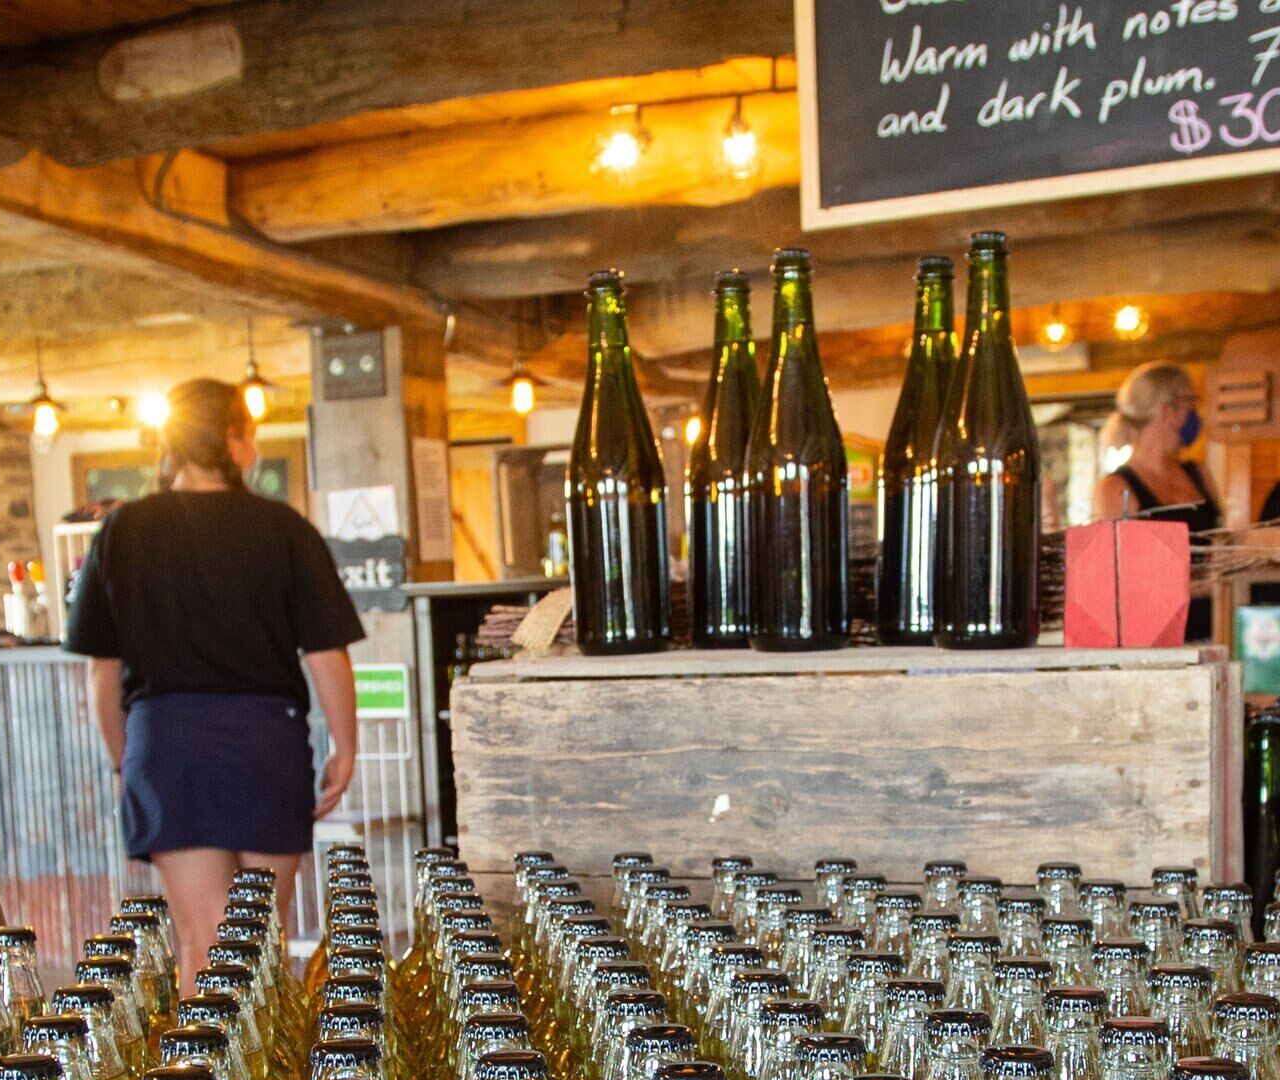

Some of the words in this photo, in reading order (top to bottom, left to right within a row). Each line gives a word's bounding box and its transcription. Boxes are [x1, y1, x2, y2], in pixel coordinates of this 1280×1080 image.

[880, 24, 988, 85] Warm
[1008, 3, 1096, 62] with
[1123, 0, 1239, 41] notes
[877, 83, 948, 138] and
[977, 66, 1081, 127] dark
[1099, 56, 1216, 124] plum.
[342, 558, 394, 589] xit
